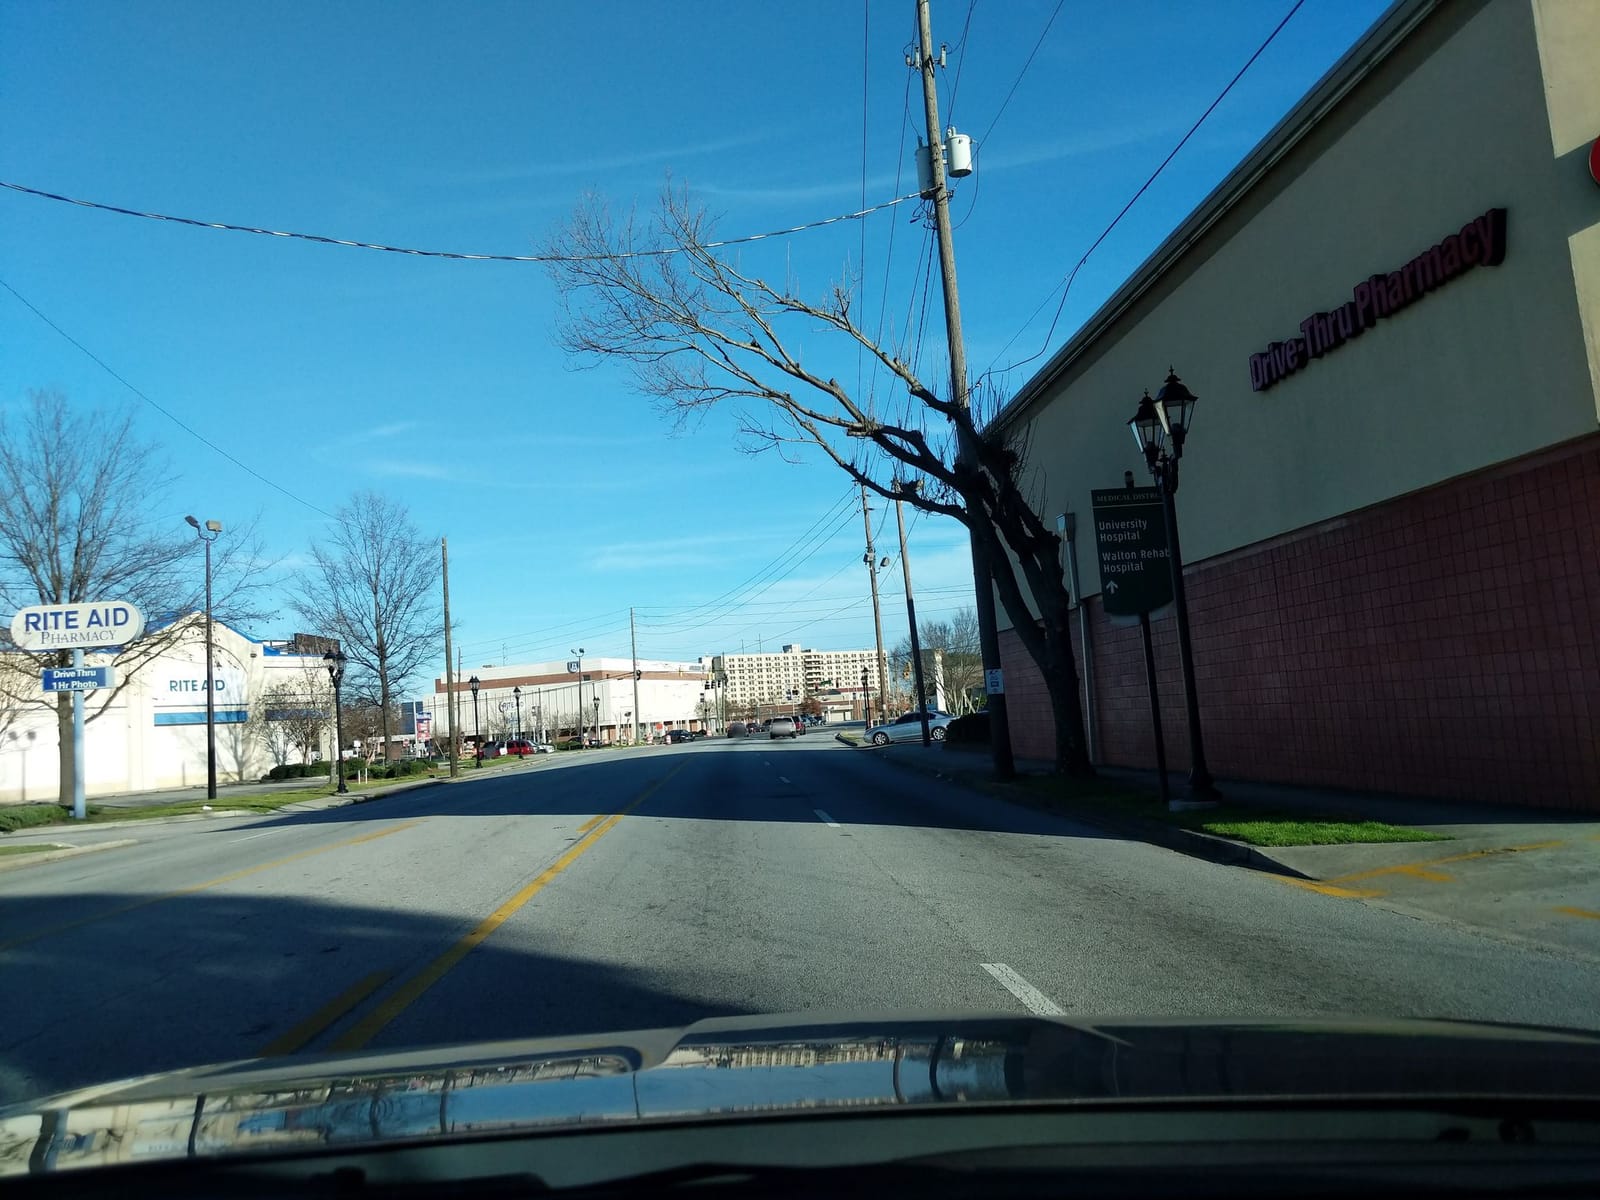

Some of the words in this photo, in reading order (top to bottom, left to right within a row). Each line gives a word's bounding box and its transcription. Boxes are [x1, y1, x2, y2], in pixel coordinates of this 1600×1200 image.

[1249, 301, 1356, 391] Drive-Thru
[1353, 207, 1507, 329] Pharmacy
[1098, 519, 1148, 531] University
[1100, 530, 1141, 543] Hospital
[1102, 550, 1137, 561] Walton
[1103, 561, 1144, 574] Hospital
[24, 609, 80, 632] RITE
[86, 606, 130, 628] AID
[41, 630, 117, 645] PHARMACY
[53, 670, 76, 679] Drive
[76, 668, 97, 677] Thru
[71, 680, 98, 689] Photo
[169, 679, 199, 692] RITE
[201, 679, 226, 691] AD
